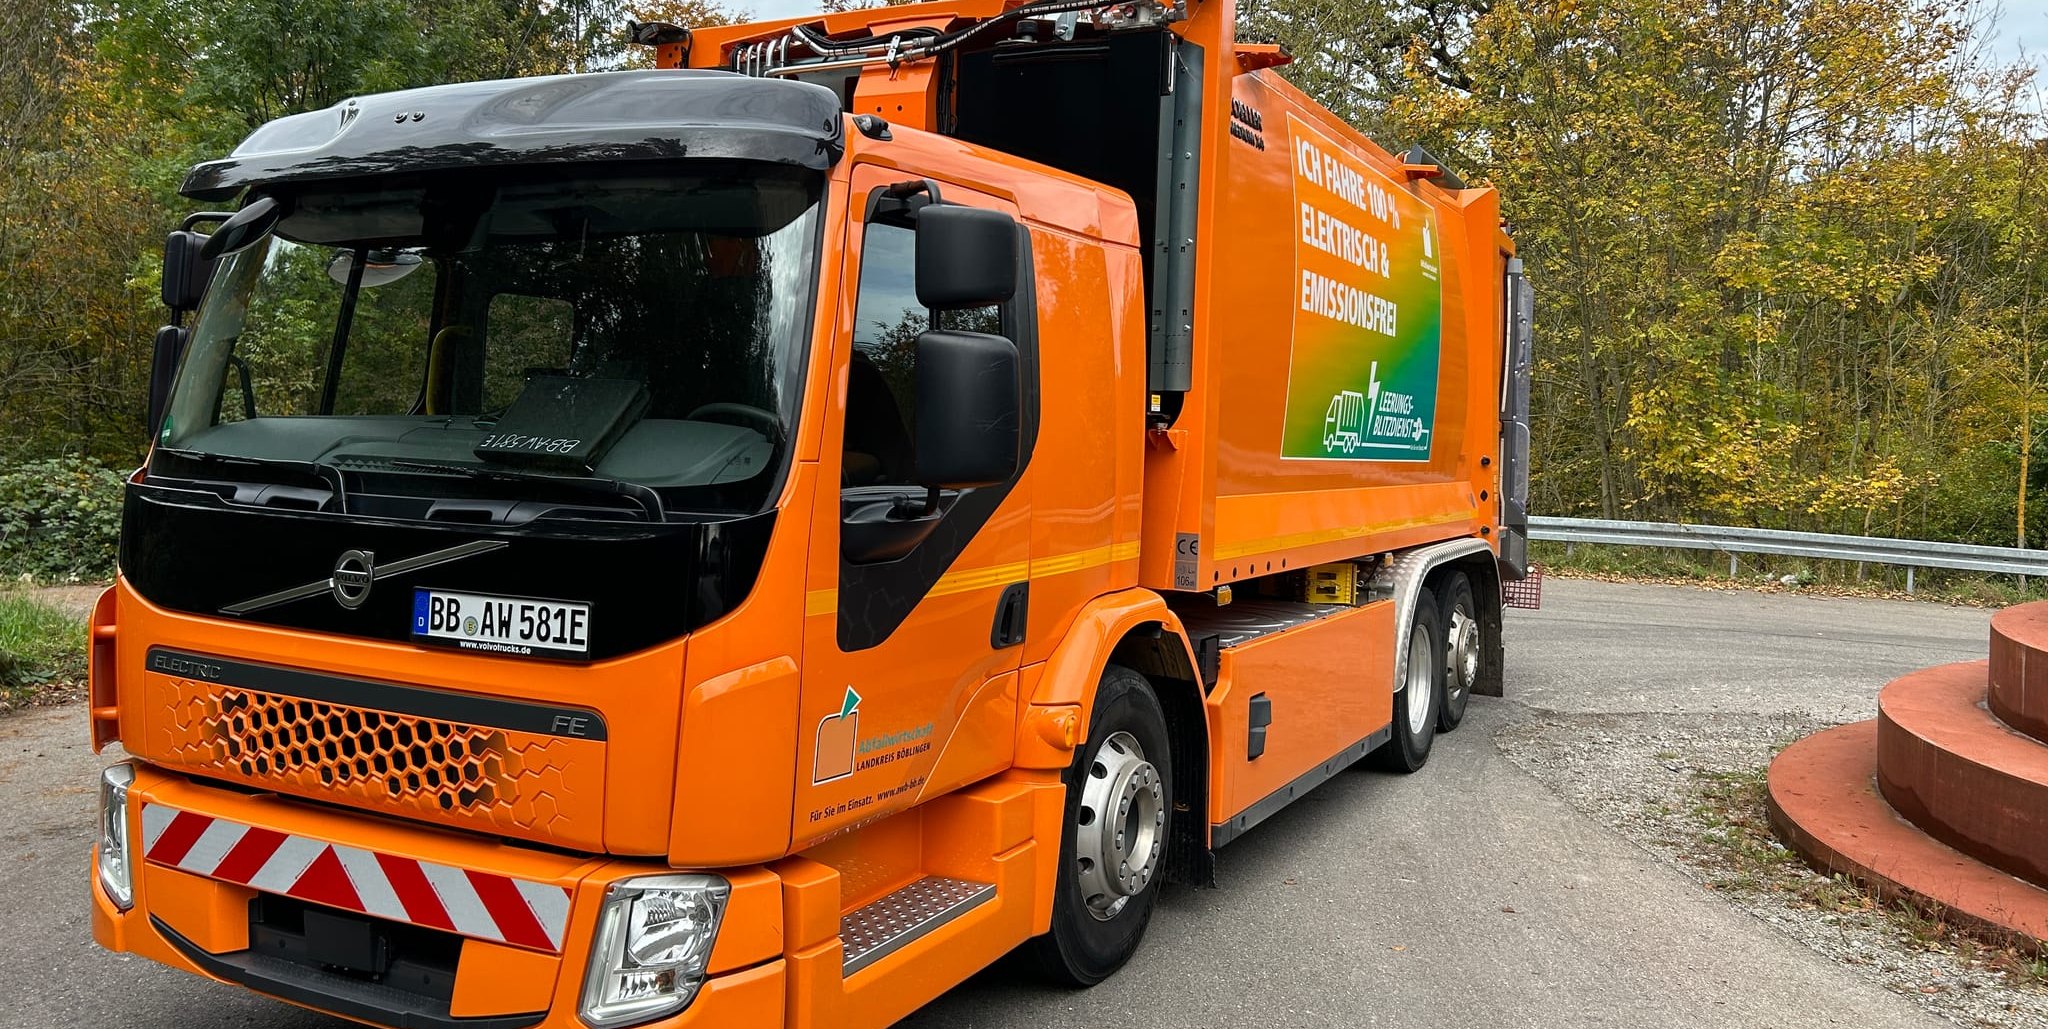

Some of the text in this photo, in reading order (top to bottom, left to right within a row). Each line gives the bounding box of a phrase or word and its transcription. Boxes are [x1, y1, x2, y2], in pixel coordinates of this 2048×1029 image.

[1295, 135, 1400, 230] ICH FAHRE 100 %
[1301, 202, 1390, 279] ELEKTRISCH &
[1301, 269, 1397, 337] EMISSIONSFREI
[1378, 391, 1414, 415] LEERUNGS-
[1372, 415, 1415, 438] BLITZDIENST
[1177, 539, 1198, 556] CE
[335, 572, 369, 583] VOLVO
[418, 597, 586, 646] D BB AW 581E
[460, 640, 531, 655] www.volvotrucks.de
[155, 655, 221, 678] ELECTRIC
[551, 715, 589, 736] FE
[858, 722, 934, 754] Abfallwirtschaft
[856, 741, 931, 772] LANDKREIS BÖBLINGEN
[809, 776, 925, 823] Für Sie im Einsatz. www.awb-bb.de
